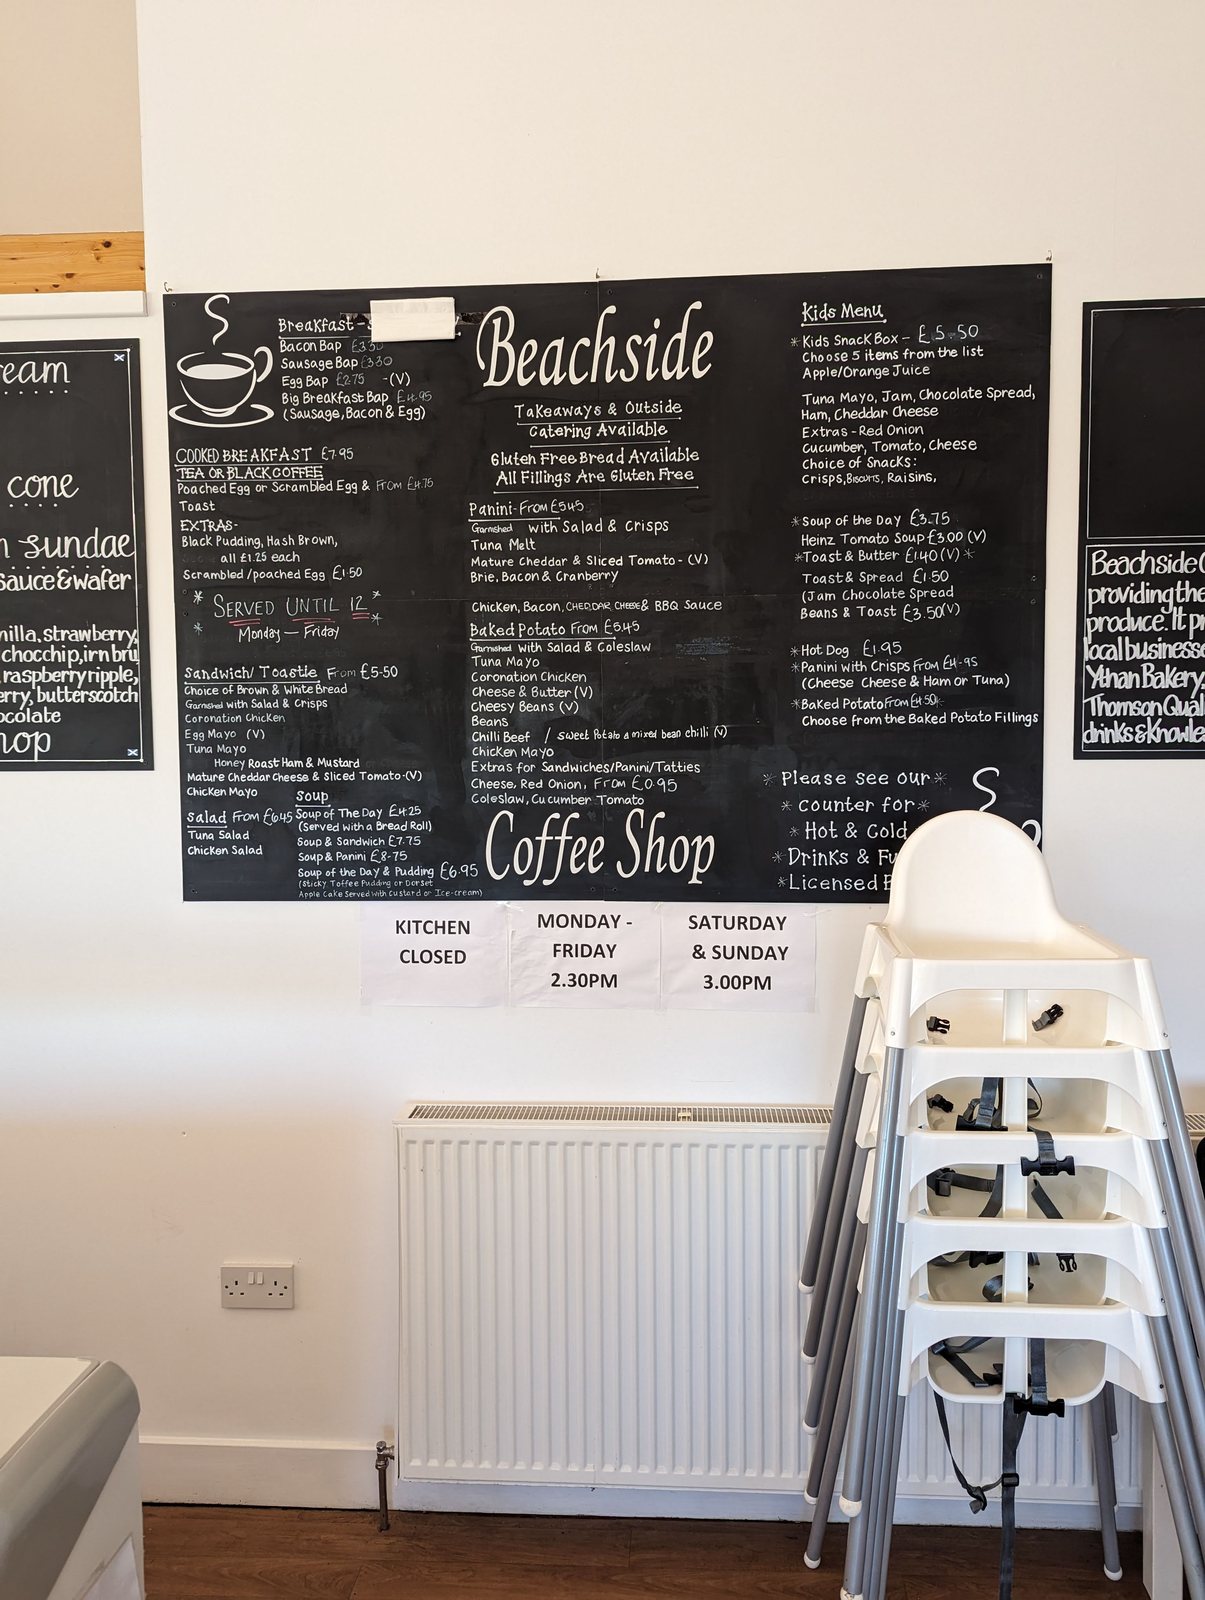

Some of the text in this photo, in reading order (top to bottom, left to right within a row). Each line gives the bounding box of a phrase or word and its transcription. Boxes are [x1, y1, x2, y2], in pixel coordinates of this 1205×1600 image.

[802, 302, 883, 321] Kids Menu
[280, 340, 341, 353] Bacon Bap
[477, 301, 713, 387] Beachside
[803, 332, 898, 348] Kids Snack Box
[0, 359, 70, 383] eam
[281, 356, 358, 371] Sausage Bap
[803, 364, 930, 380] Apple/Orange Juice
[282, 375, 328, 388] Egg Bap
[282, 391, 388, 406] Big Breakfast Bap
[514, 399, 682, 419] Takeaways & Outside
[802, 406, 938, 422] Ham, Cheddar Cheese
[529, 421, 668, 439] Catering Available
[176, 448, 219, 463] COOKED
[223, 447, 313, 464] BREAKFAST
[491, 447, 699, 466] Gluten Free Bread Available
[176, 466, 323, 479] TEA OR BLACK COFFEE
[496, 468, 694, 487] All Fillings Are Gluten Free
[7, 474, 79, 498] cone
[178, 483, 226, 494] Poached
[230, 483, 250, 495] Egg
[272, 481, 332, 492] Scrambled
[336, 480, 357, 494] Egg
[362, 480, 370, 490] &
[179, 501, 215, 511] Toast
[803, 517, 831, 528] Soup
[836, 515, 848, 526] of
[853, 515, 872, 525] the
[877, 515, 901, 527] Day
[18, 527, 135, 558] sundae
[182, 535, 337, 549] Black Pudding, Hash Brown,
[471, 538, 535, 551] Tuna Melt
[802, 532, 925, 546] Heinz Tomato Soup
[221, 553, 235, 563] all
[271, 551, 300, 562] each
[1091, 550, 1198, 575] Beachside
[1088, 581, 1173, 614] providing
[214, 594, 367, 617] SERVED UNTIL 12
[239, 624, 339, 643] Monday Friday
[470, 622, 565, 638] Baked Potato
[802, 644, 823, 656] Hot
[827, 645, 849, 658] Dog
[1083, 637, 1122, 661] local
[327, 667, 355, 680] From
[472, 671, 586, 682] Coronation Chicken
[1086, 665, 1140, 689] Ythan
[37, 686, 138, 703] butterscotch
[185, 682, 347, 695] Choice of Brown & White Bread
[472, 685, 592, 699] Cheese & Butter (V)
[471, 701, 514, 713] Cheesy
[519, 701, 554, 712] Beans
[1083, 694, 1162, 717] Thomson
[472, 731, 530, 742] Chilli Beef
[186, 744, 246, 756] Tuna Mayo
[782, 770, 930, 786] Please see our
[187, 787, 257, 798] Chicken Mayo
[296, 791, 328, 804] Soup
[799, 797, 915, 812] counter for
[187, 810, 226, 823] Salad
[299, 821, 339, 832] (Served
[343, 822, 364, 831] with
[376, 821, 407, 831] Bread
[410, 821, 431, 832] Roll)
[805, 821, 907, 840] Hot & Cold
[188, 830, 249, 840] Tuna Salad
[297, 837, 322, 847] Soup
[325, 837, 332, 846] &
[337, 837, 385, 846] Sandwich
[486, 808, 714, 886] Coffee Shop
[788, 848, 869, 866] Drinks &
[298, 868, 322, 879] Soup
[326, 868, 336, 877] of
[340, 868, 356, 877] the
[360, 868, 379, 878] Day
[383, 866, 389, 876] &
[395, 866, 434, 878] Pudding
[790, 874, 877, 890] Licensed
[396, 920, 470, 934] KITCHEN
[538, 914, 621, 928] MONDAY
[689, 915, 786, 930] SATURDAY
[400, 950, 466, 964] CLOSED
[554, 944, 616, 958] FRIDAY
[692, 945, 788, 960] & SUNDAY
[552, 973, 617, 988] 2.30PM
[704, 975, 771, 990] 3.00PM
